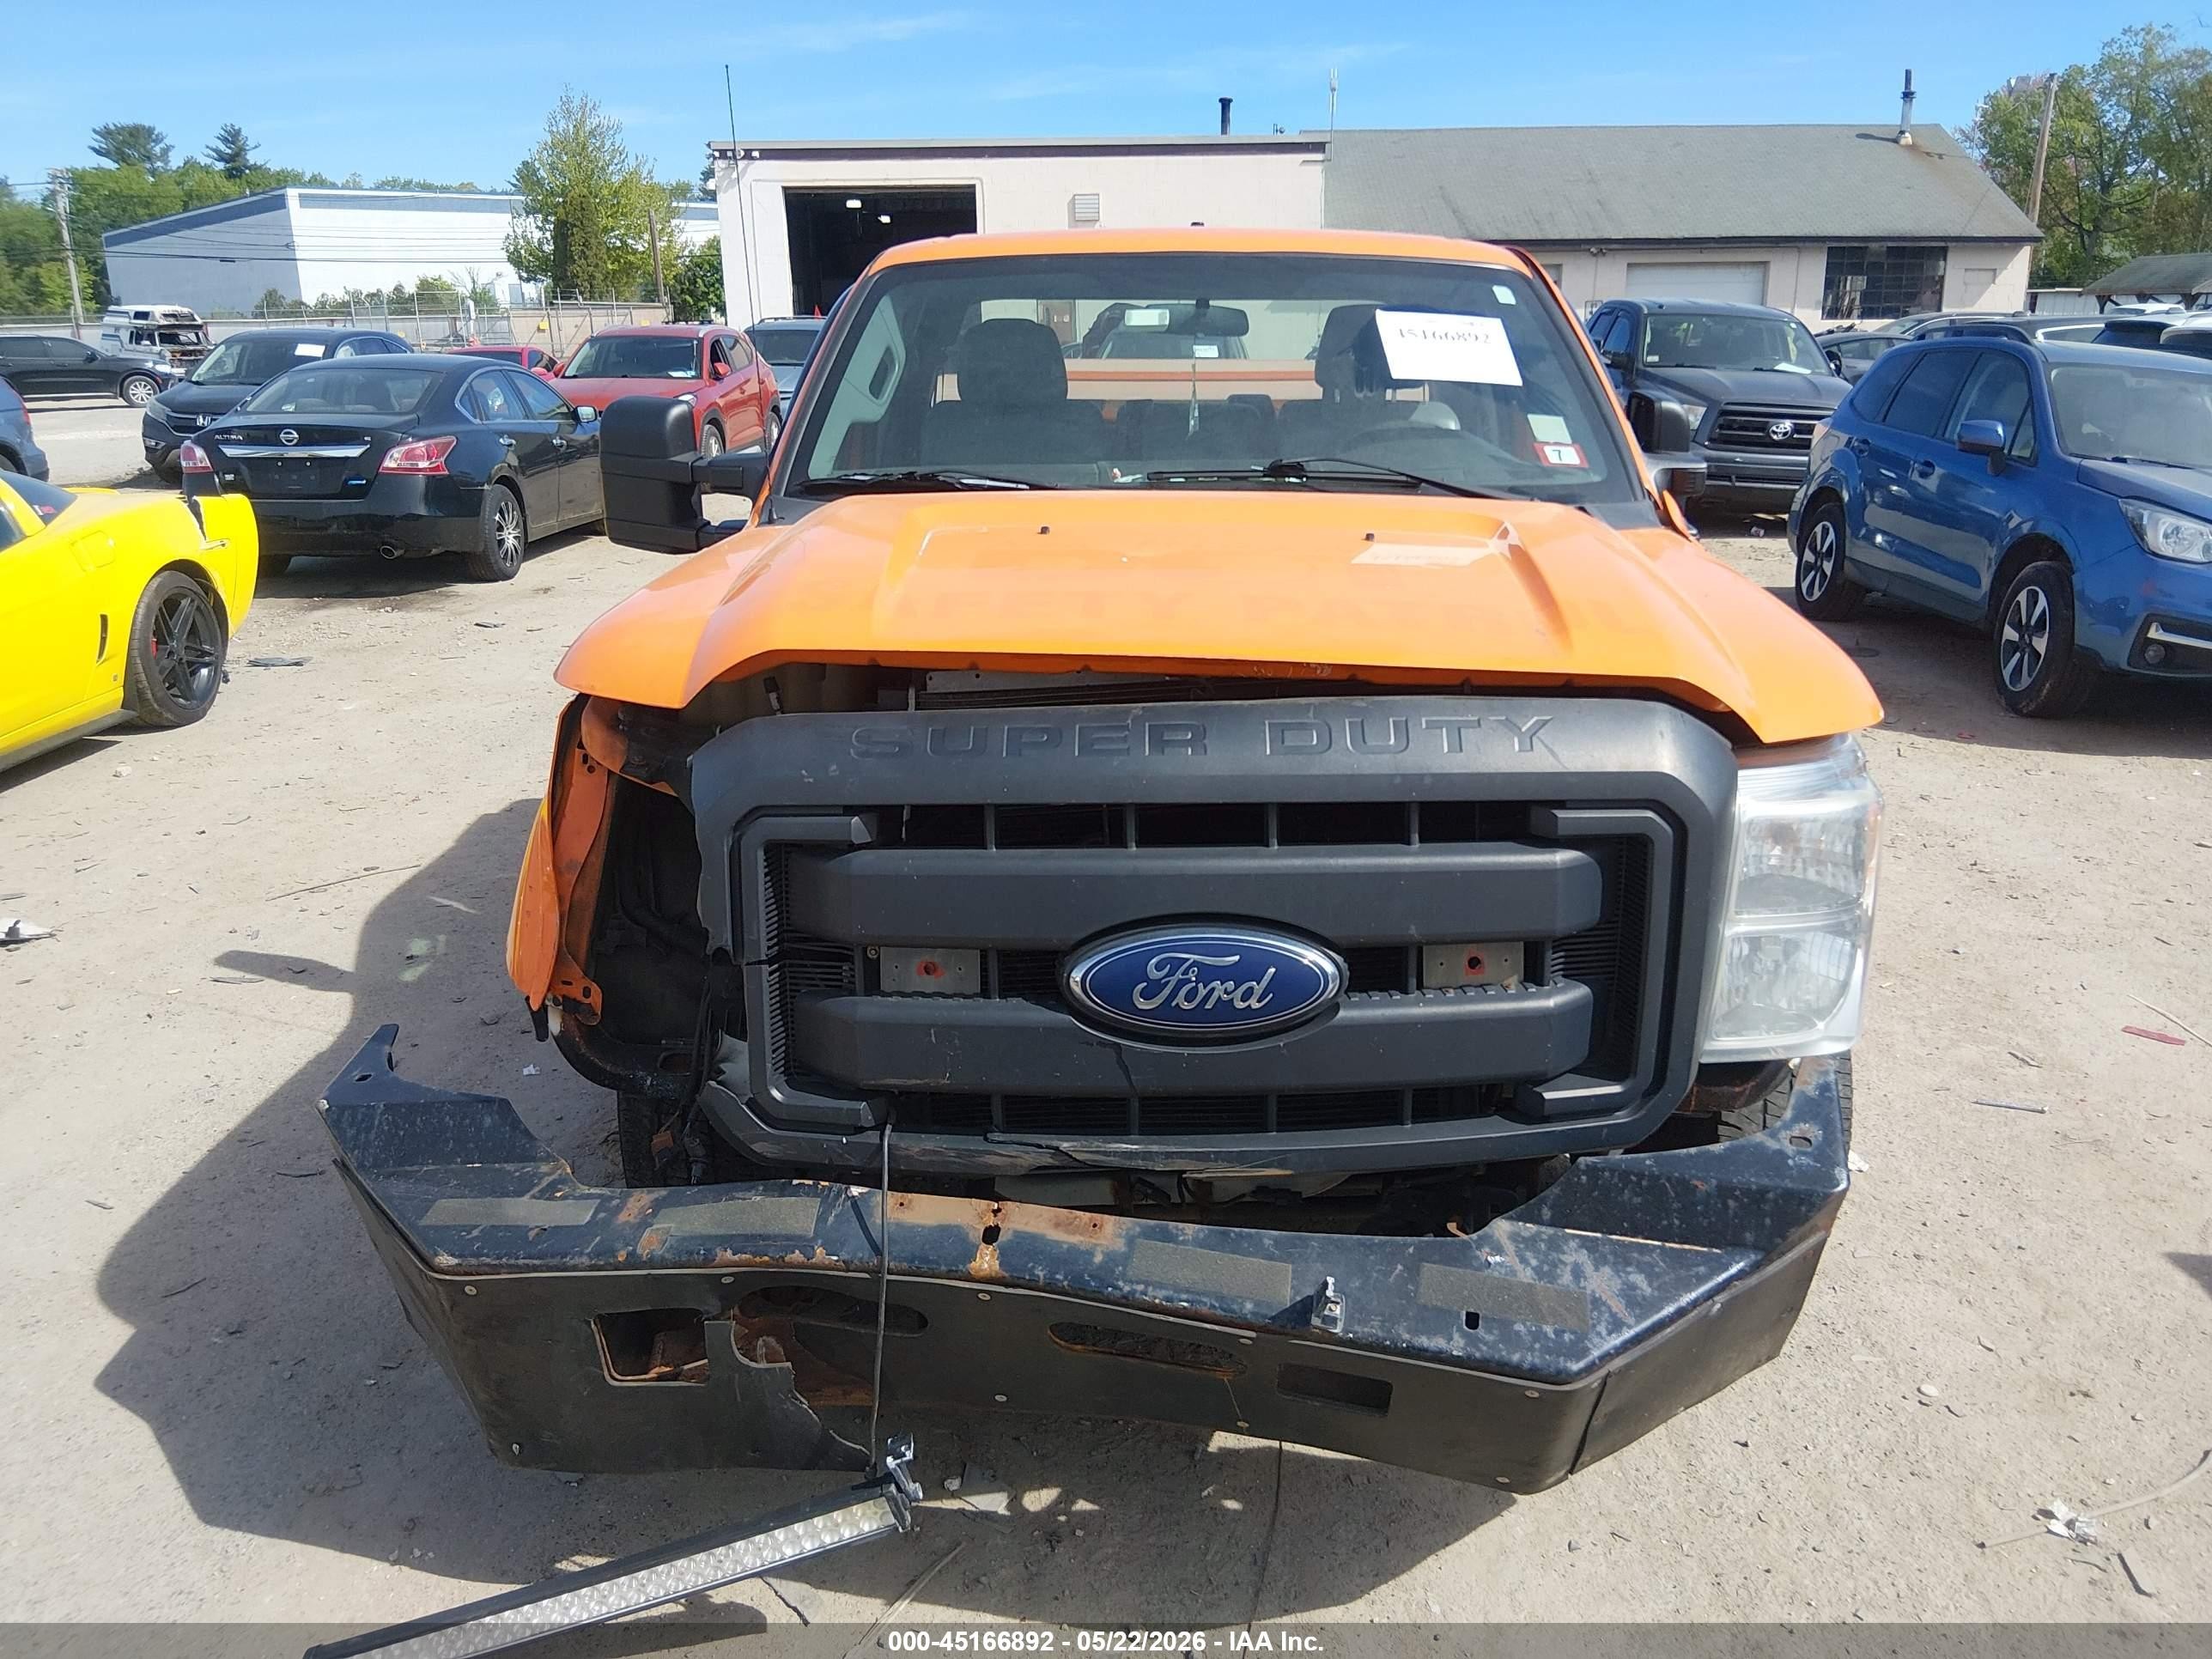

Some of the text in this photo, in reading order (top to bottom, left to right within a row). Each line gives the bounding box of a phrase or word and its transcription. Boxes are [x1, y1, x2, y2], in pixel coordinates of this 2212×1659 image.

[1552, 449, 1563, 461] 7
[849, 715, 1553, 760] SUPER DUTY
[1132, 951, 1277, 1011] Ford
